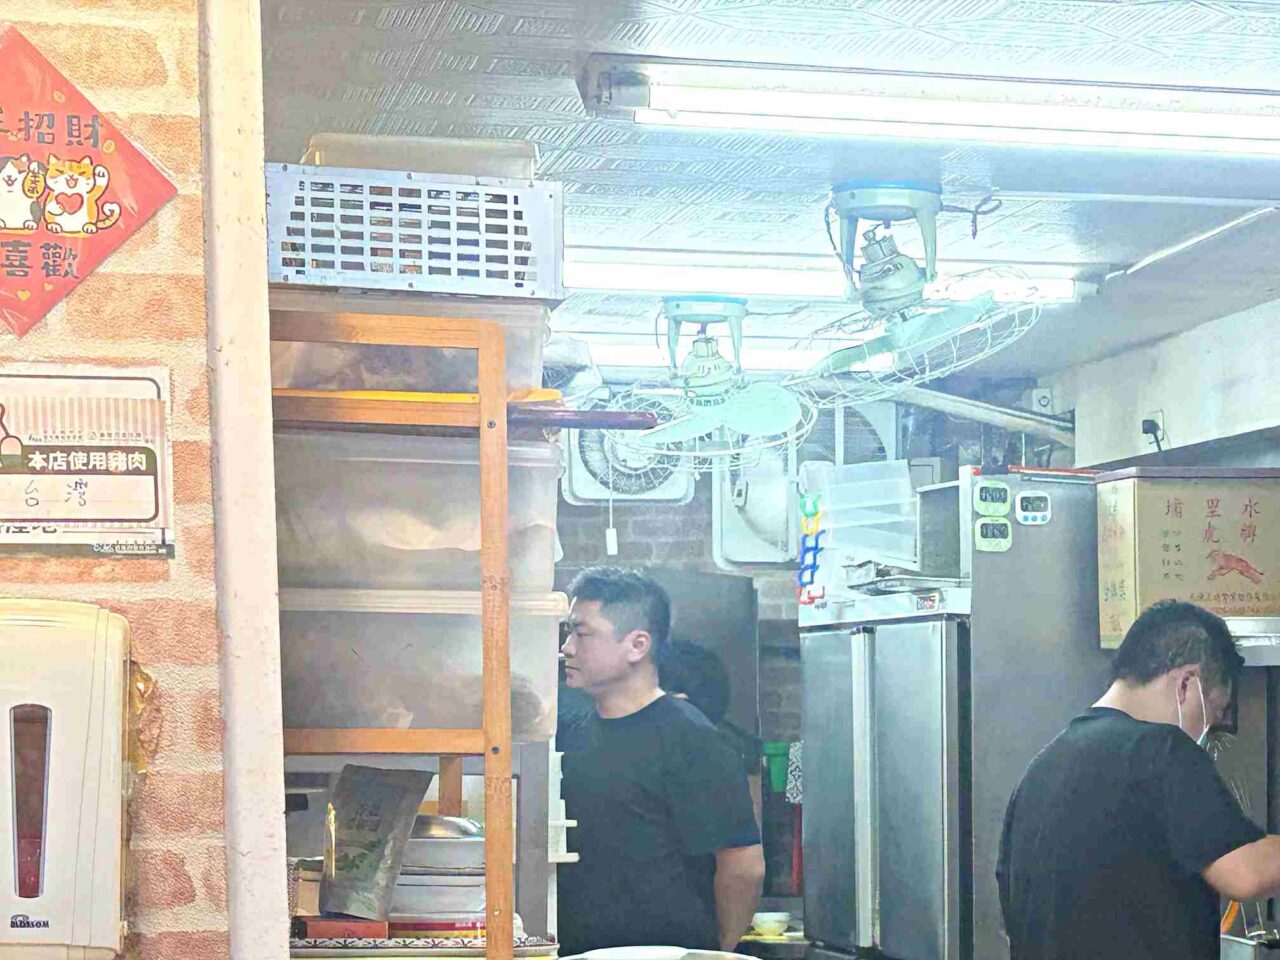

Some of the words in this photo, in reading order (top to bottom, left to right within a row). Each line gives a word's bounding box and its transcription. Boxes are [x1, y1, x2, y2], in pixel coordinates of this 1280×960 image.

[27, 450, 147, 472] 本店使用豬肉
